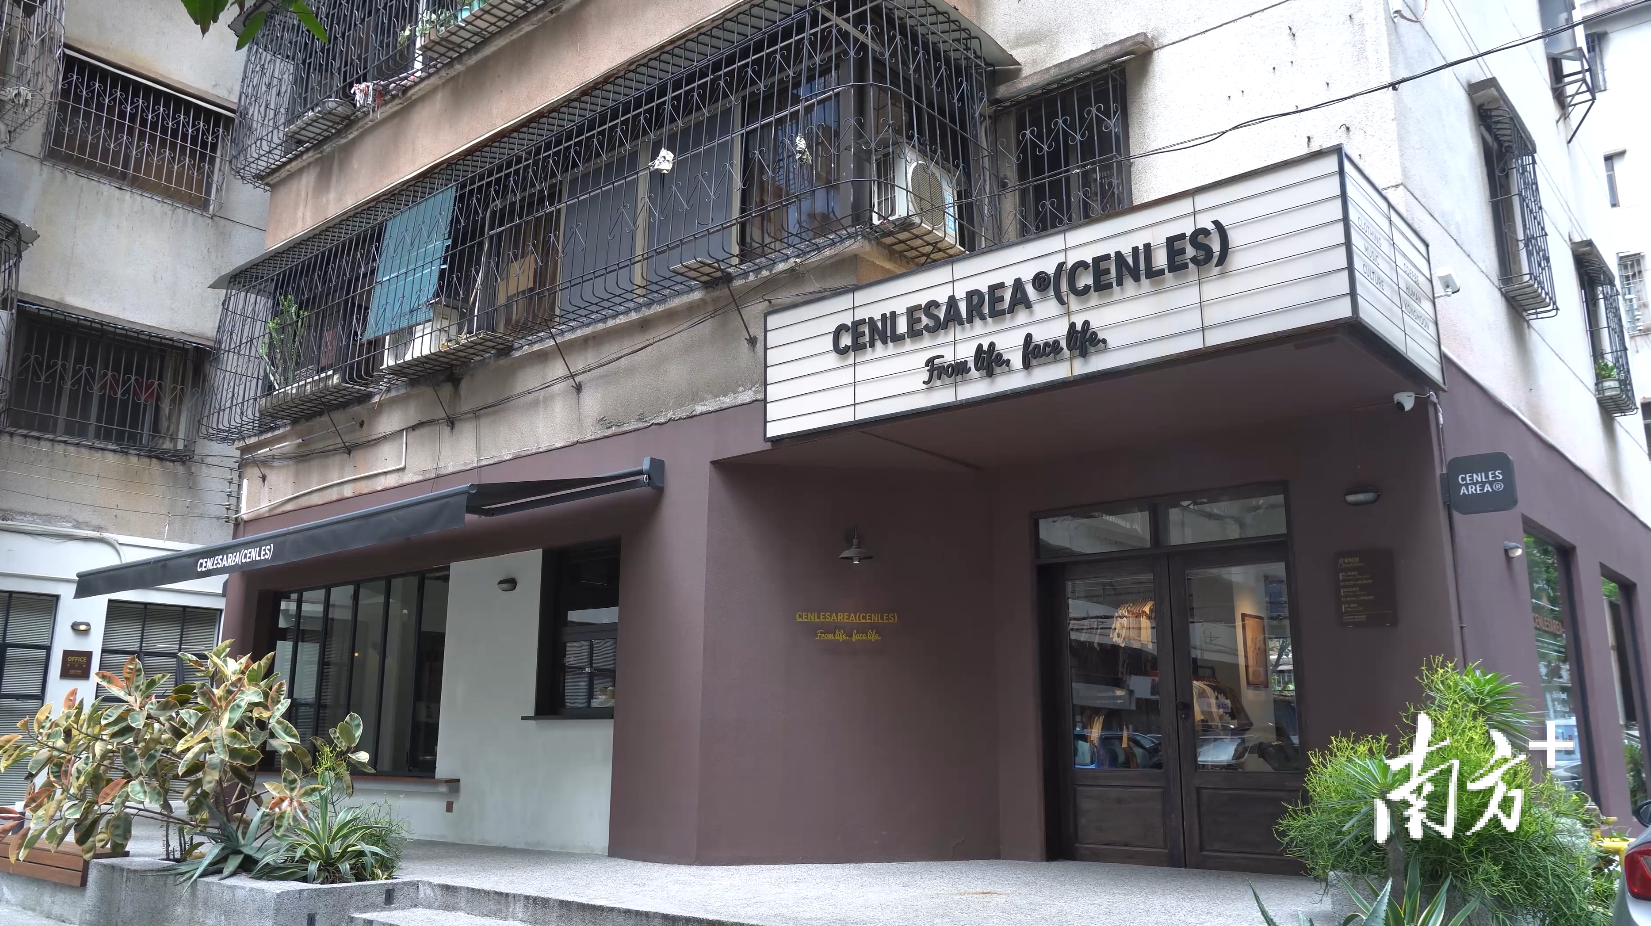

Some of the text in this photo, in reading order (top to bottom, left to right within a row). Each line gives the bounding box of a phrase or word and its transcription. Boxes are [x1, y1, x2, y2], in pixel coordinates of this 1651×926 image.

[1362, 263, 1385, 291] CULTURE
[923, 354, 972, 386] From
[973, 341, 1011, 379] life,
[1021, 332, 1064, 370] face
[1458, 470, 1503, 484] CENLES
[196, 543, 274, 572] CENLESAREA(CENLES)
[796, 611, 898, 622] CENLESAREA(CENLES)
[815, 629, 835, 640] From
[852, 629, 867, 642] face
